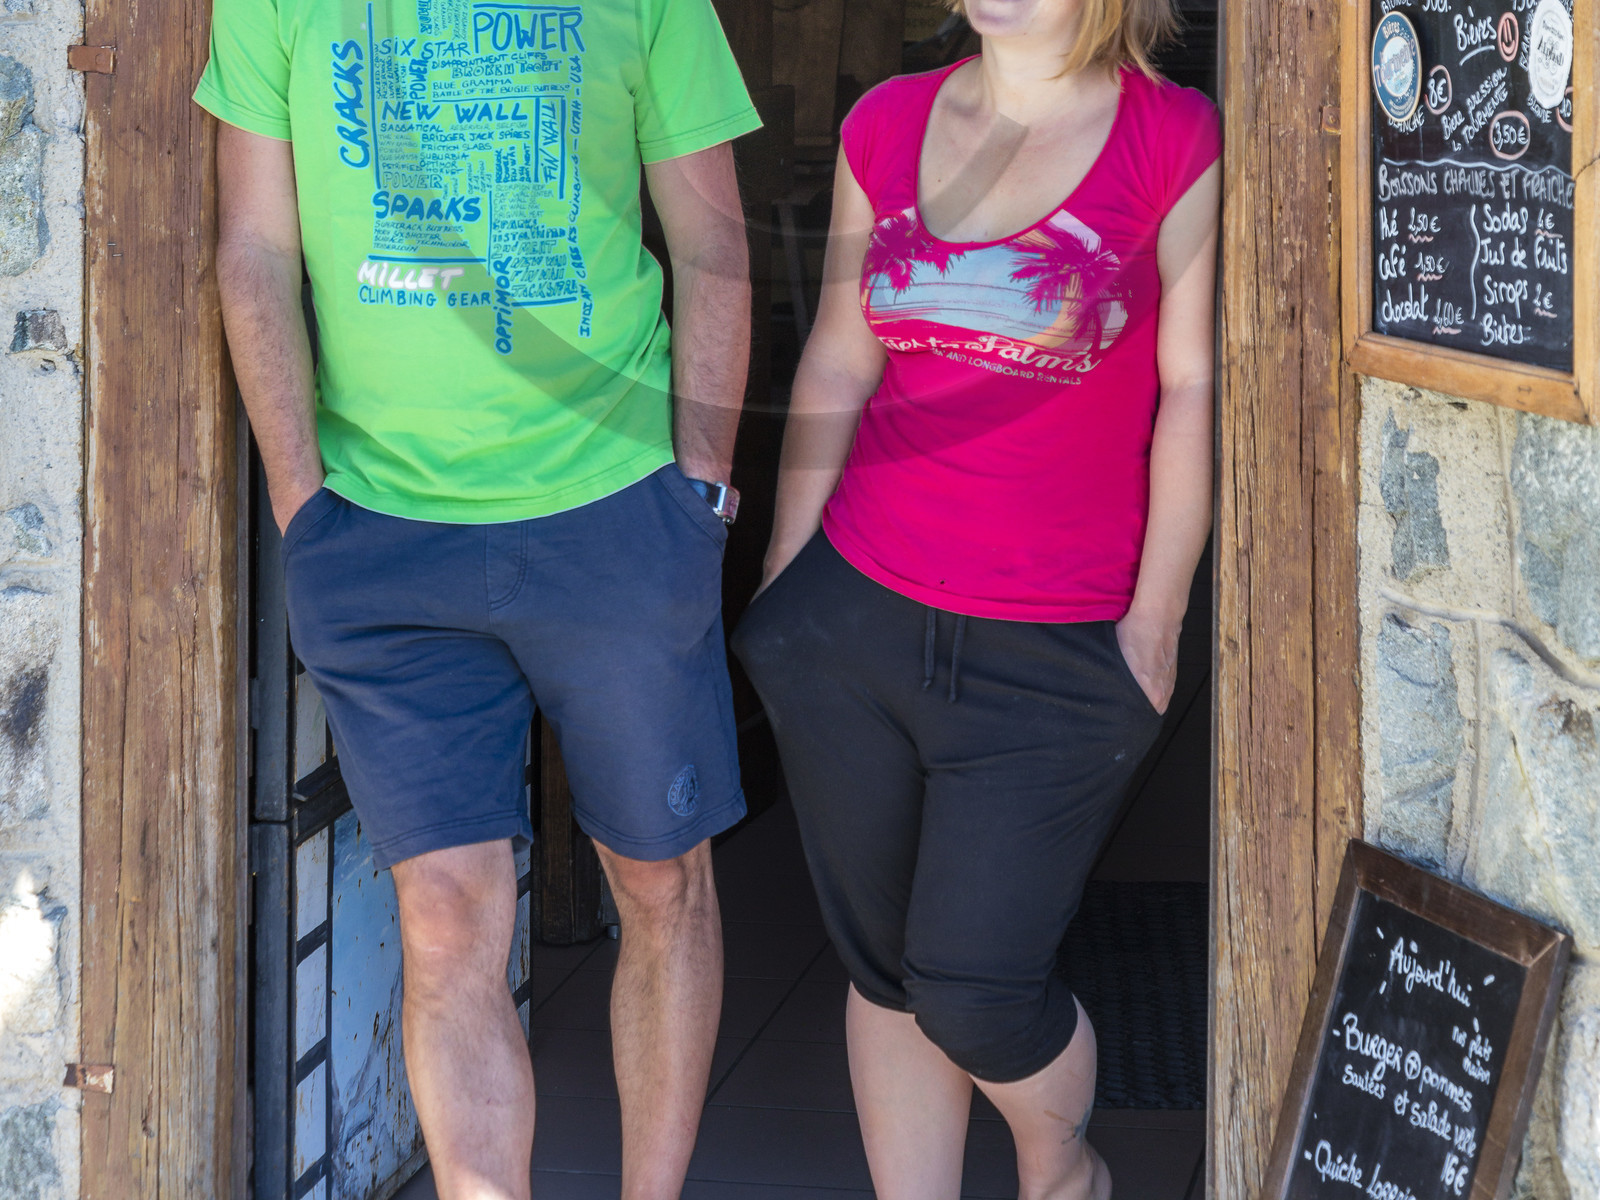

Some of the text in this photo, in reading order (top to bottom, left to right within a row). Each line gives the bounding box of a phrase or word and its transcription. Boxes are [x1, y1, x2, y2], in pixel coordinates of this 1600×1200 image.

[421, 41, 471, 59] STAR
[473, 12, 584, 52] POWER
[409, 58, 428, 100] POWER
[433, 78, 512, 90] BLUE GRAMMA
[569, 55, 582, 84] USA
[332, 39, 370, 168] CRACKS
[382, 101, 528, 123] NEW WALL
[571, 99, 582, 135] UTAH
[469, 131, 495, 141] JACK
[540, 102, 558, 147] WALL
[462, 142, 492, 150] SLABS
[383, 172, 443, 189] POWER
[373, 191, 482, 222] SPARKS
[1480, 237, 1505, 265] Jus
[1510, 236, 1528, 269] de
[359, 285, 492, 308] CLIMBING GEAR
[1483, 274, 1528, 319] Sirops
[968, 356, 1034, 379] LONGBOARD
[1314, 1139, 1363, 1189] Quiche
